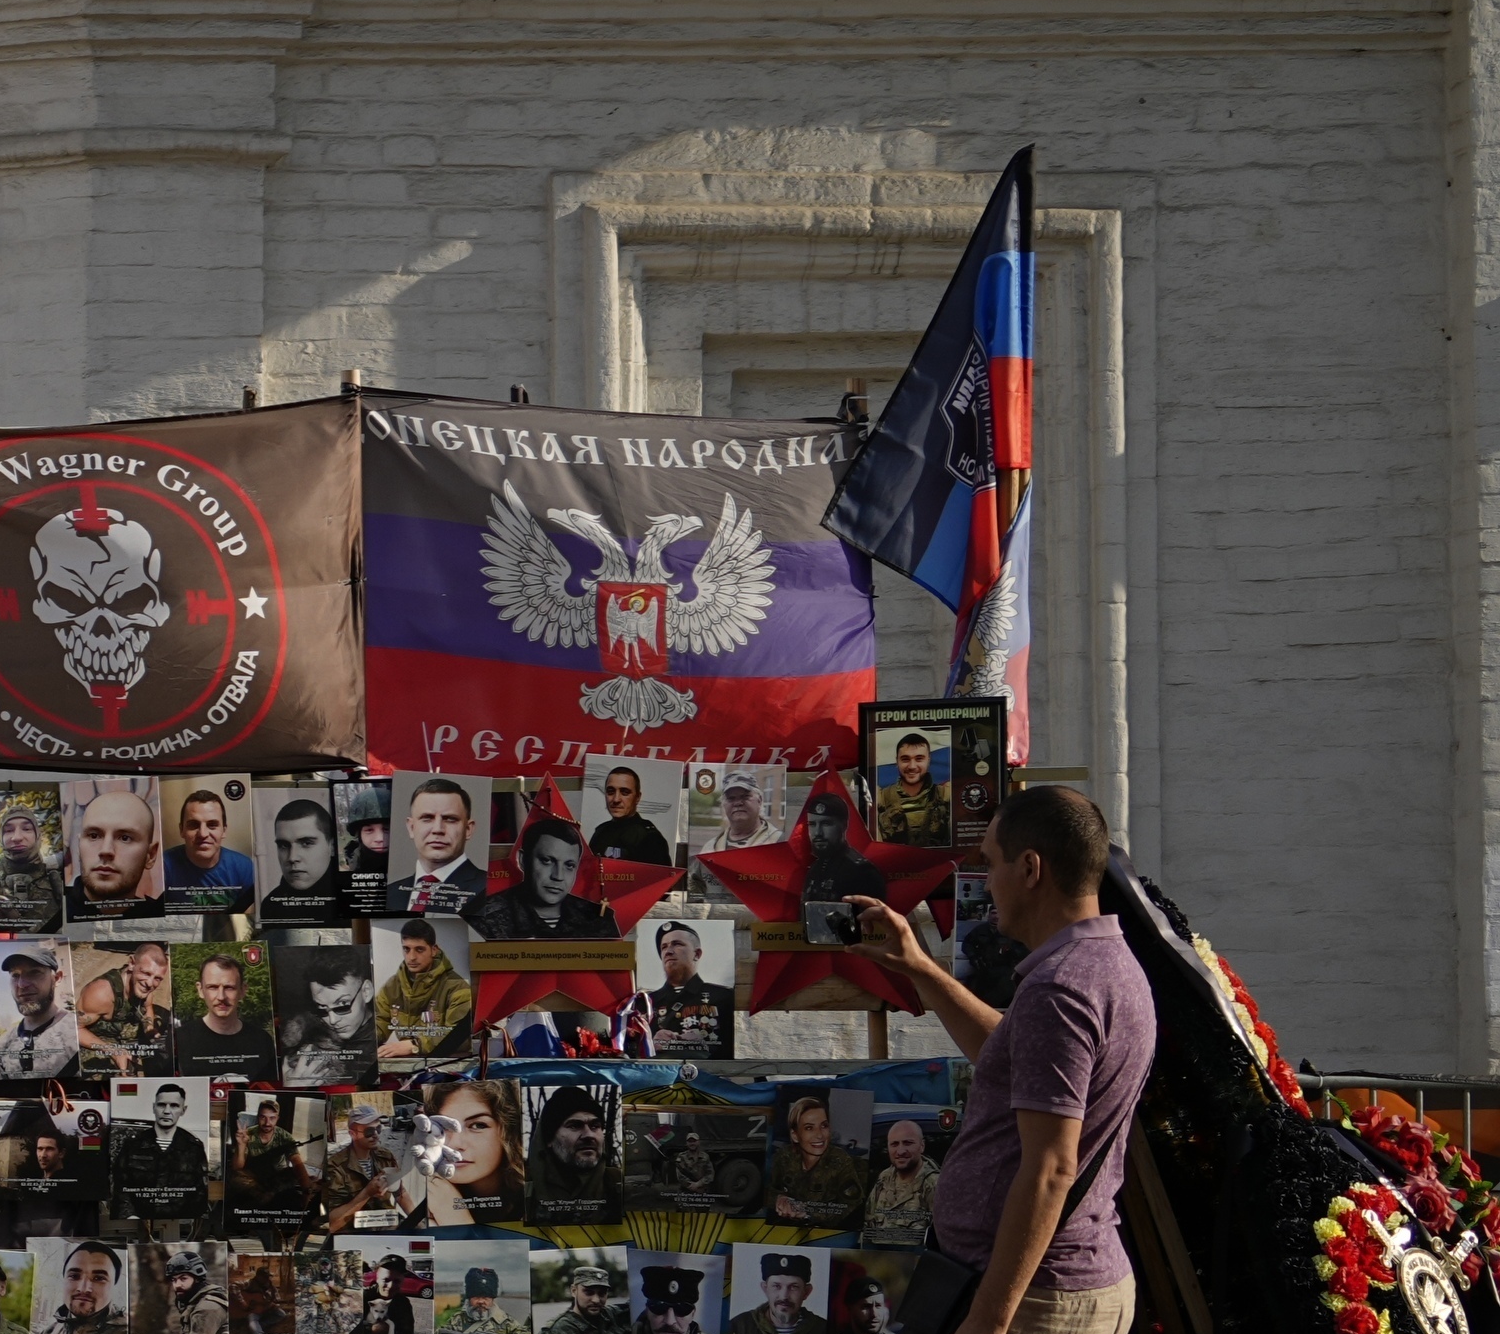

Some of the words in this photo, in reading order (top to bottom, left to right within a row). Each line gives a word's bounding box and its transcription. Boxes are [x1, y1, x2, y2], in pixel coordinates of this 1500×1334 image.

[359, 409, 605, 466] ОНЕЦКАЯ
[154, 463, 250, 559] Group
[11, 715, 77, 758] ЧЕСТЬ
[100, 727, 204, 761] РОДИНА
[205, 648, 260, 727] ОТВАГА
[874, 709, 907, 723] ГЕРОИ
[909, 706, 990, 721] СПЕЦОПЕРАЦИИ
[756, 931, 786, 943] Жога
[474, 951, 520, 961] Александр
[520, 951, 582, 961] Владимирович
[582, 951, 630, 961] Захарченко
